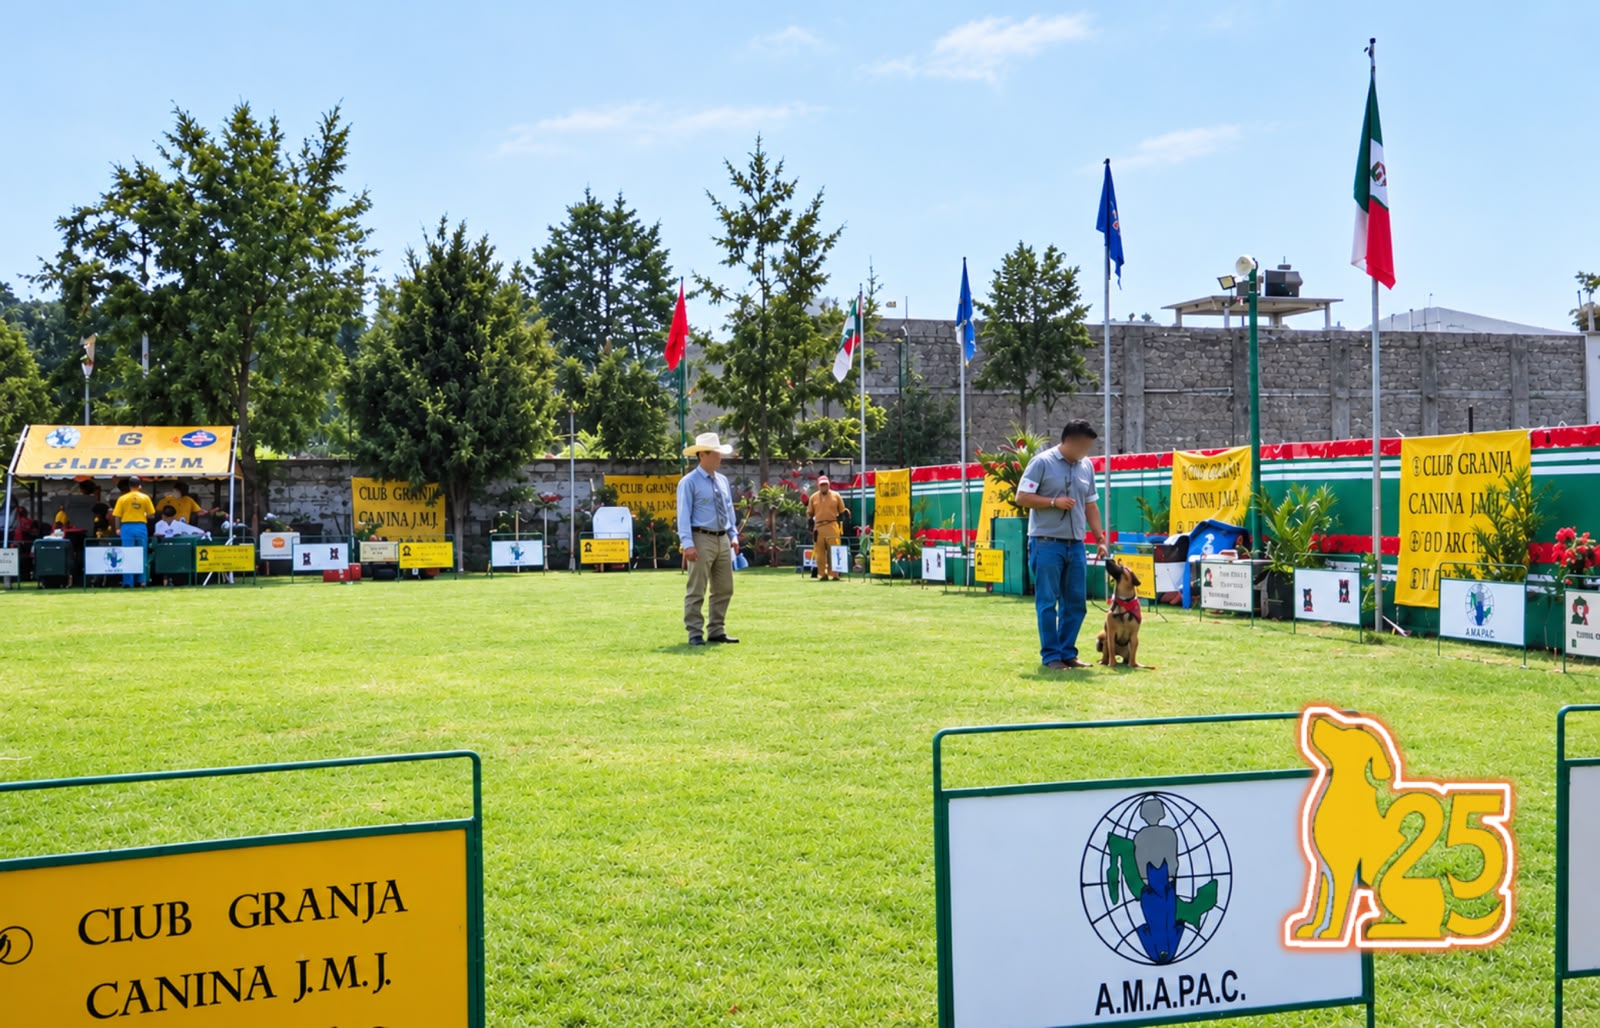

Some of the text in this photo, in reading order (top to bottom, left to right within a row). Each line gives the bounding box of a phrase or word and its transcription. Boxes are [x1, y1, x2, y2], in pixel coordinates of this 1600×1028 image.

[1423, 451, 1513, 479] CLUB GRANJA
[359, 486, 388, 501] CLUB
[620, 482, 643, 494] CLUB
[1408, 492, 1465, 514] CANINA
[358, 511, 409, 527] CANINA
[78, 879, 408, 946] CLUB GRANJA
[86, 964, 277, 1020] CANINA
[1094, 969, 1246, 1016] A.M.A.P.A.C.
